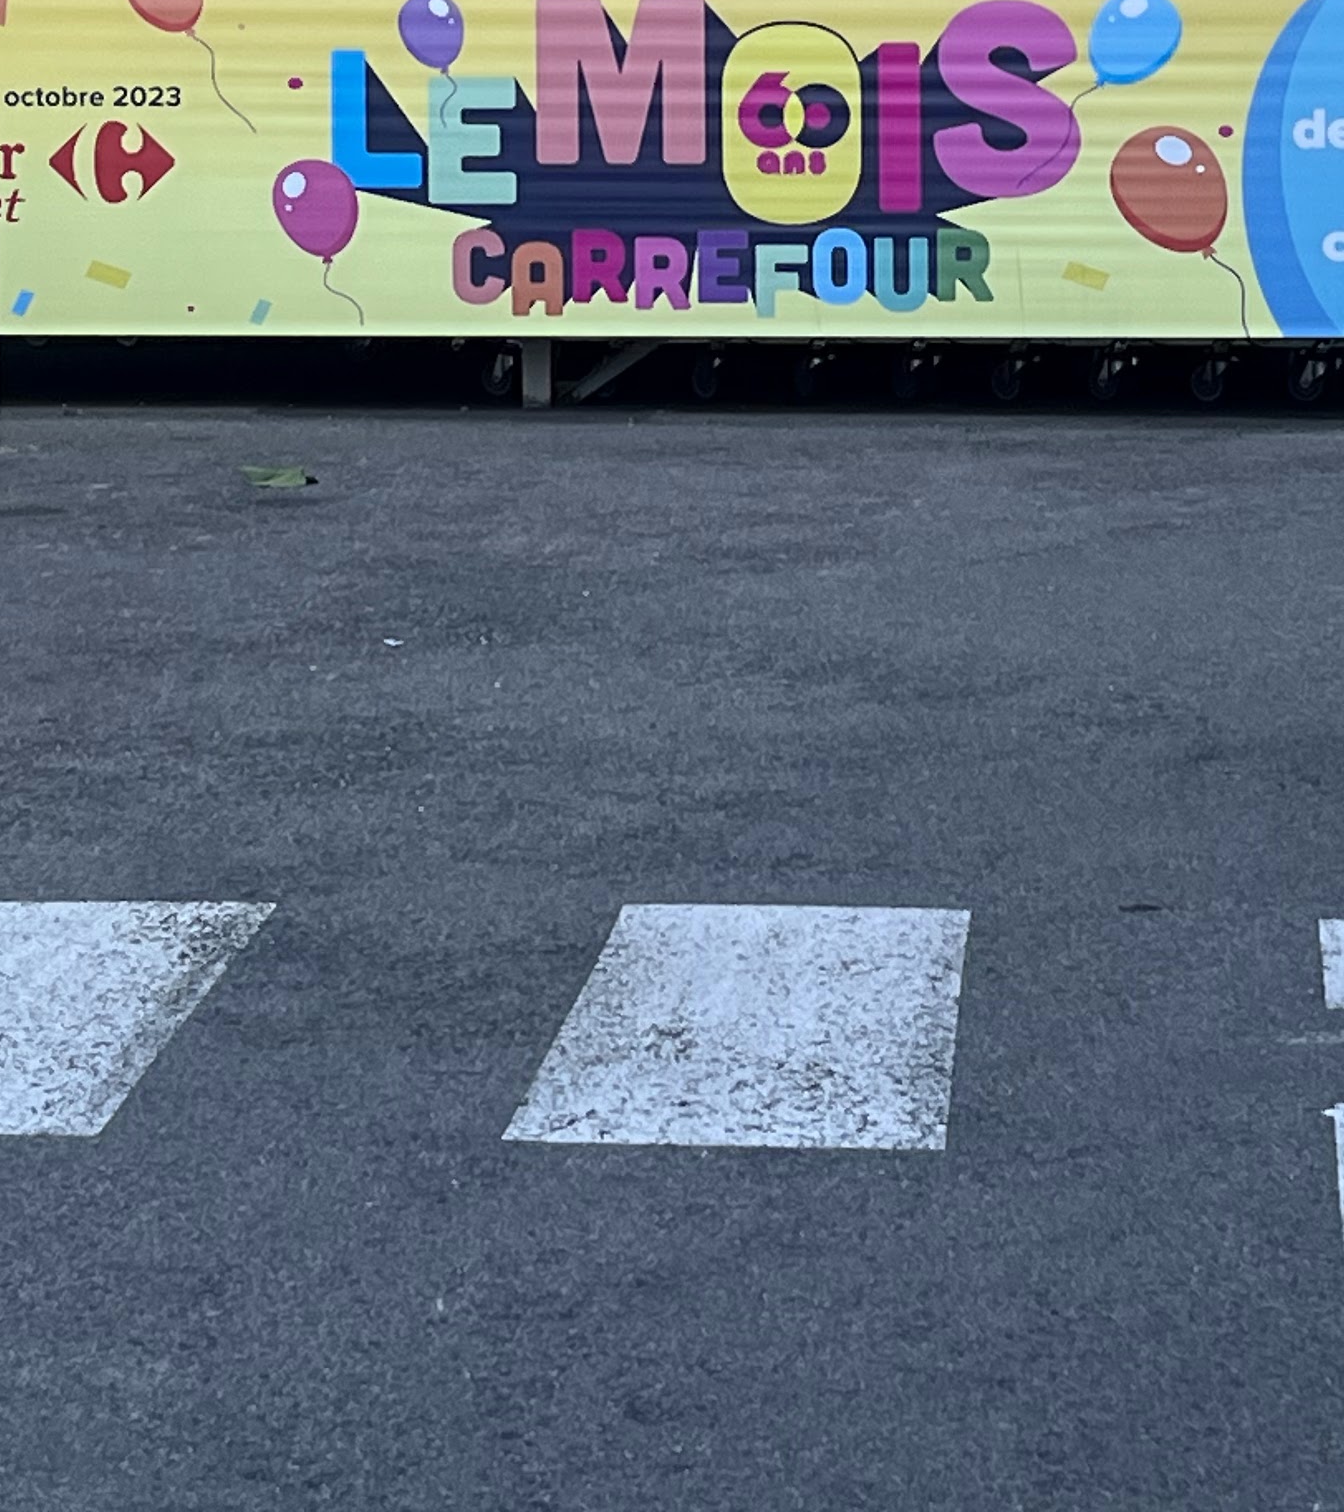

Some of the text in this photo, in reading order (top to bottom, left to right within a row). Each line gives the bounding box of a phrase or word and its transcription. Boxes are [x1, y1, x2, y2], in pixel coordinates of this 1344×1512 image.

[3, 86, 105, 107] octobre
[112, 86, 182, 107] 2023
[330, 49, 517, 205] LE
[756, 150, 826, 175] ans
[452, 227, 993, 318] CARREFOUR
